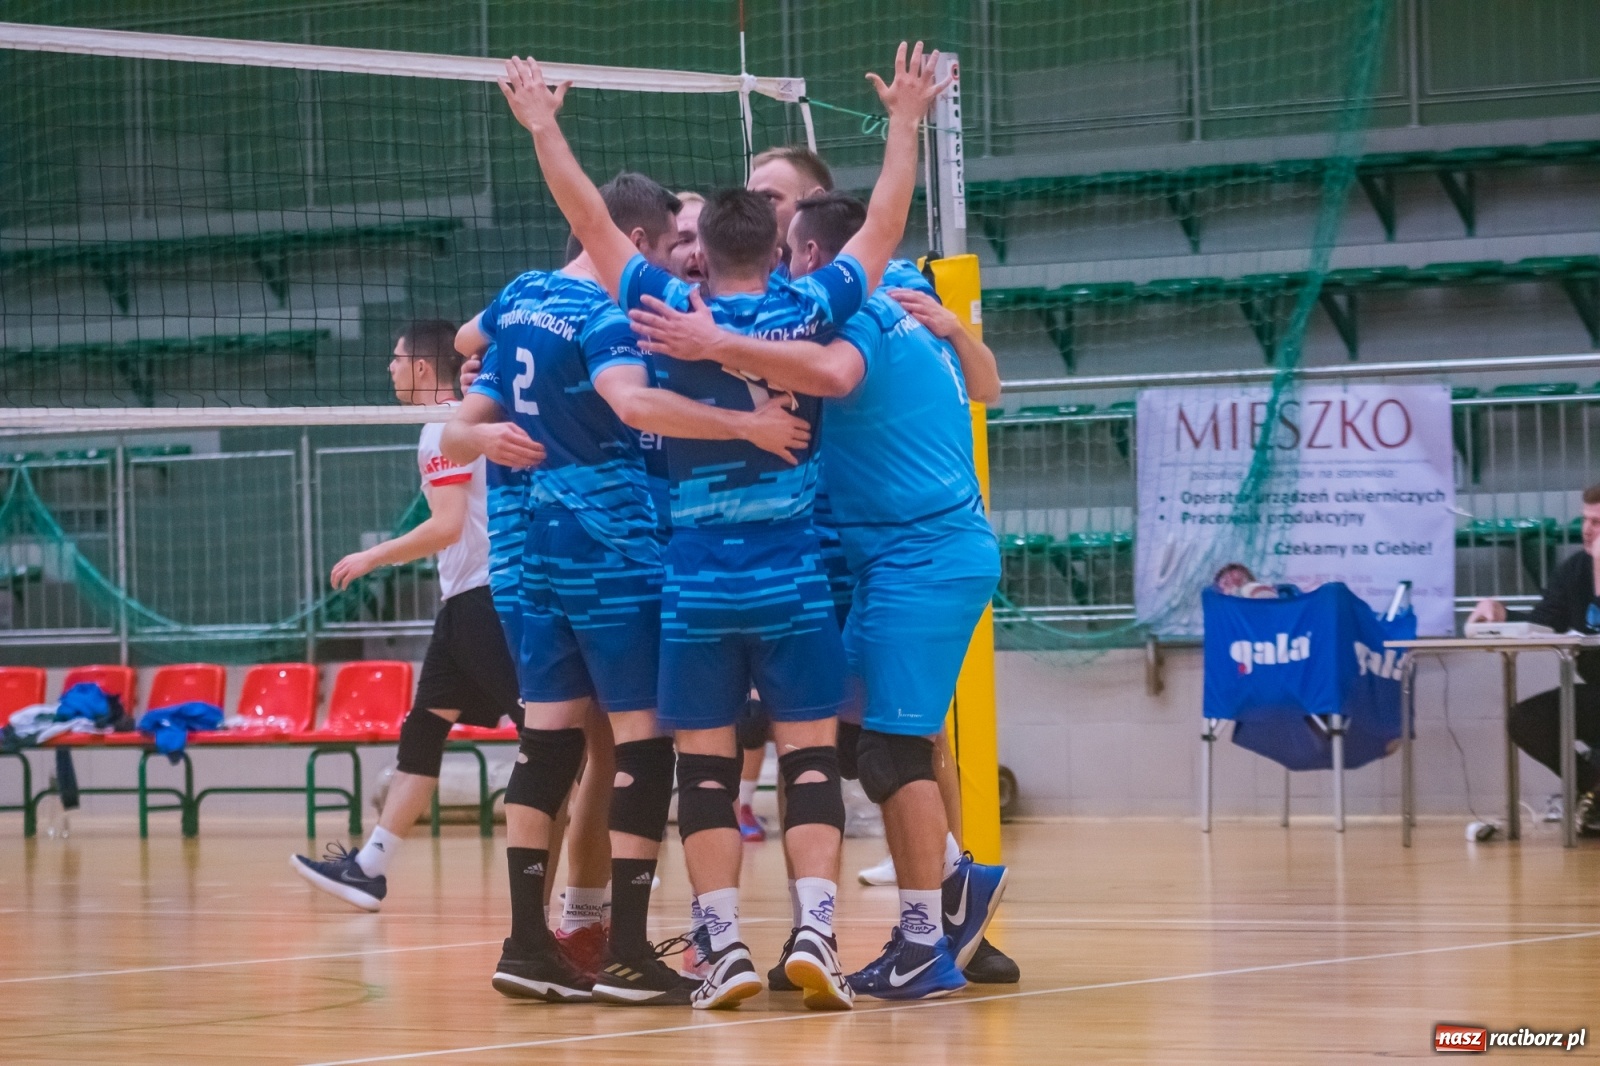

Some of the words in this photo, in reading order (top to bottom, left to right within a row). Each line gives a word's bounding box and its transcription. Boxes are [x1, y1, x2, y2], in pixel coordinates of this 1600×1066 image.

[512, 346, 540, 416] 2
[1175, 398, 1413, 451] MIESZKO
[1334, 488, 1445, 506] cukierniczych
[1267, 509, 1365, 526] produkcyjny
[1274, 542, 1348, 558] Czekamy
[1352, 544, 1369, 555] na
[1375, 541, 1432, 556] Ciebie!
[1229, 632, 1311, 675] gala
